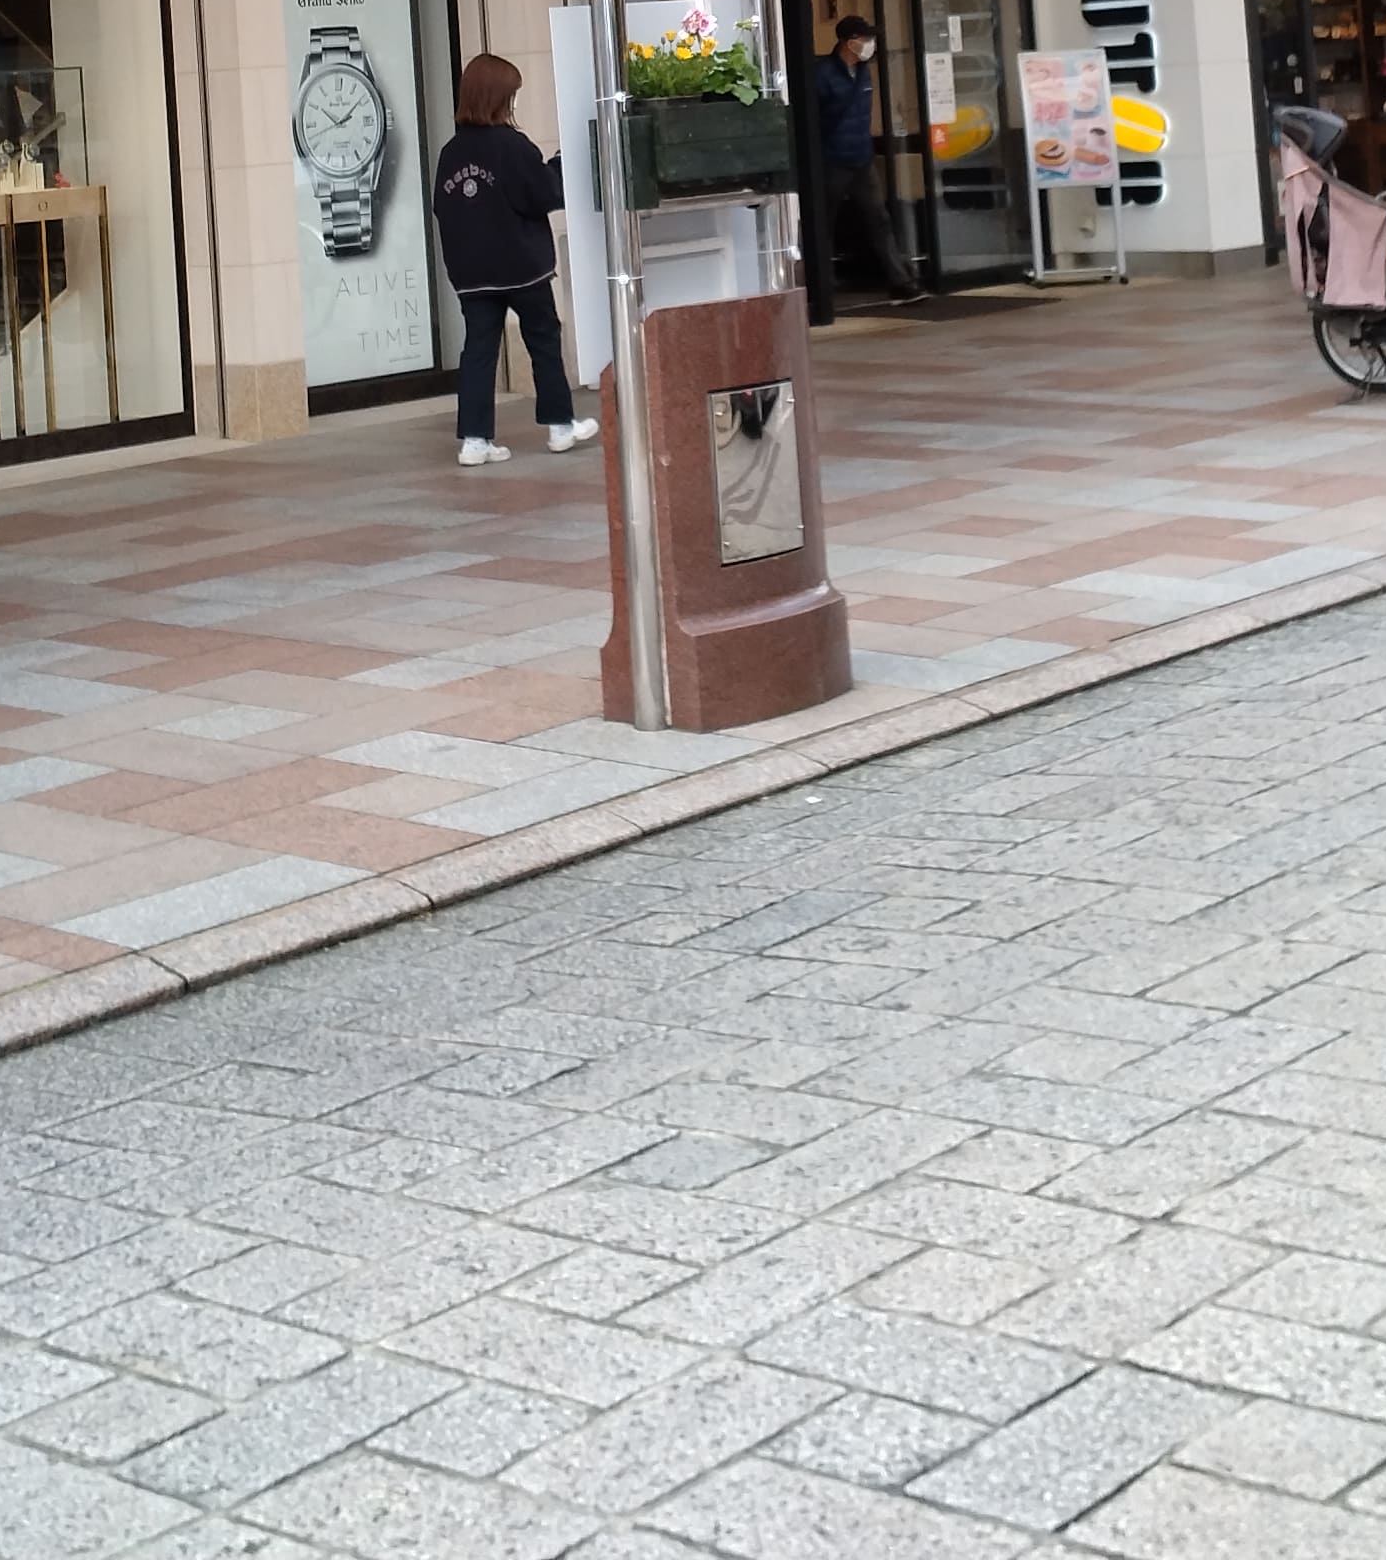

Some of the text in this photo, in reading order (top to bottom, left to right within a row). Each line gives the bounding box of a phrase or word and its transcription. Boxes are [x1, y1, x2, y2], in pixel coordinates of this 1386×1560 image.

[336, 269, 417, 299] ALIVE
[394, 298, 419, 320] IN
[357, 325, 421, 353] TIME
